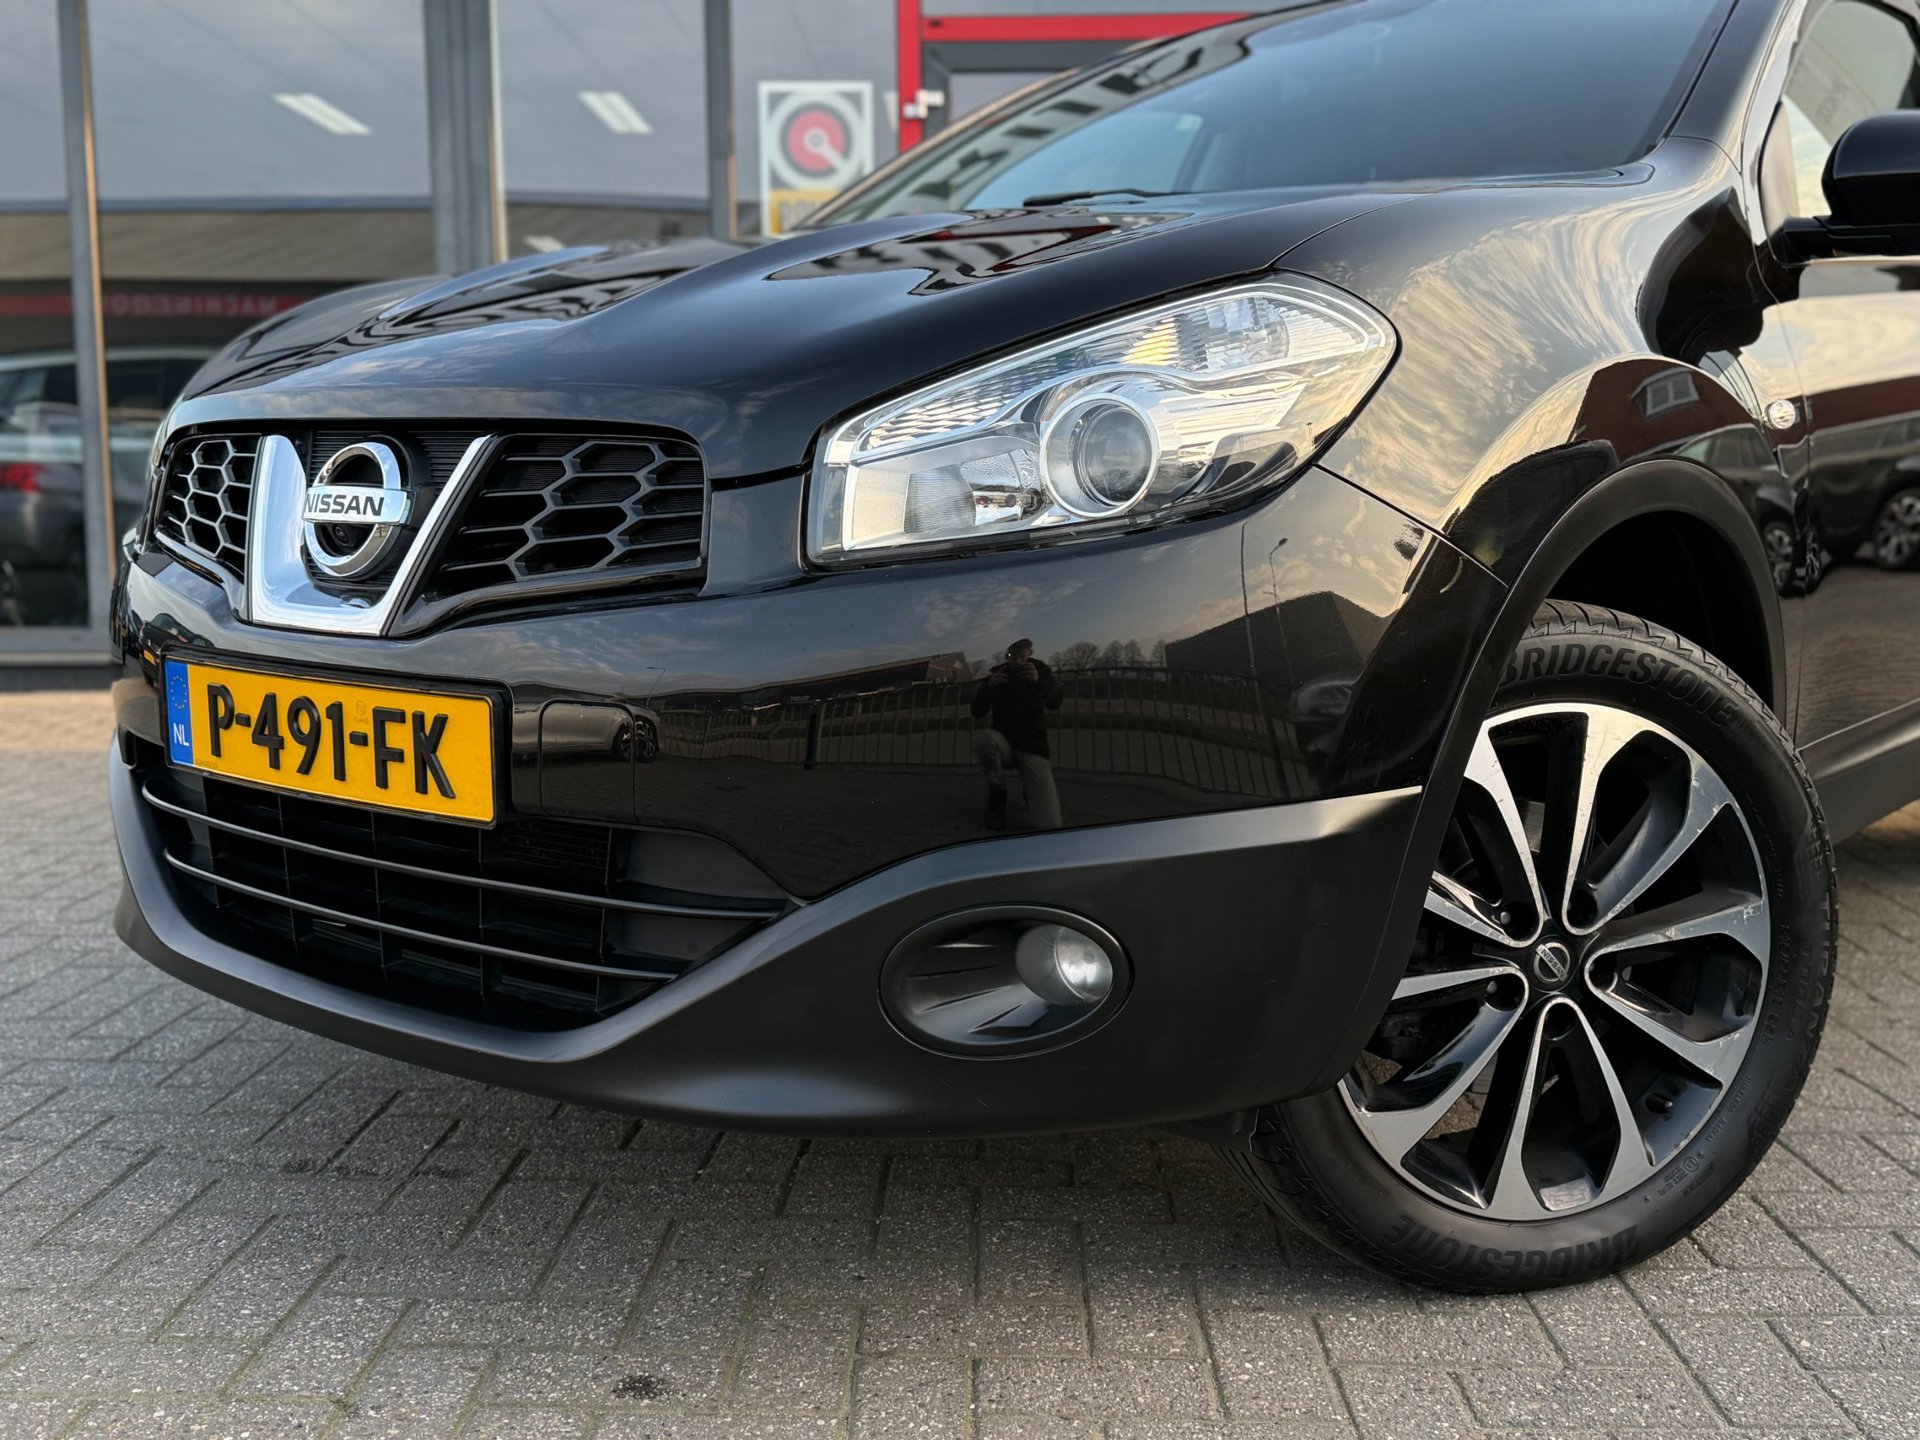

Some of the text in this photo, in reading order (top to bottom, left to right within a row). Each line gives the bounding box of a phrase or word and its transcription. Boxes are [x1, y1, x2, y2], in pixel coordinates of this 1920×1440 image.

[304, 493, 384, 516] NISSAN
[173, 722, 189, 746] NL
[207, 682, 455, 798] P-491-FK
[1541, 949, 1565, 977] NISSAN
[1384, 1216, 1638, 1280] BRIDGESTONE
